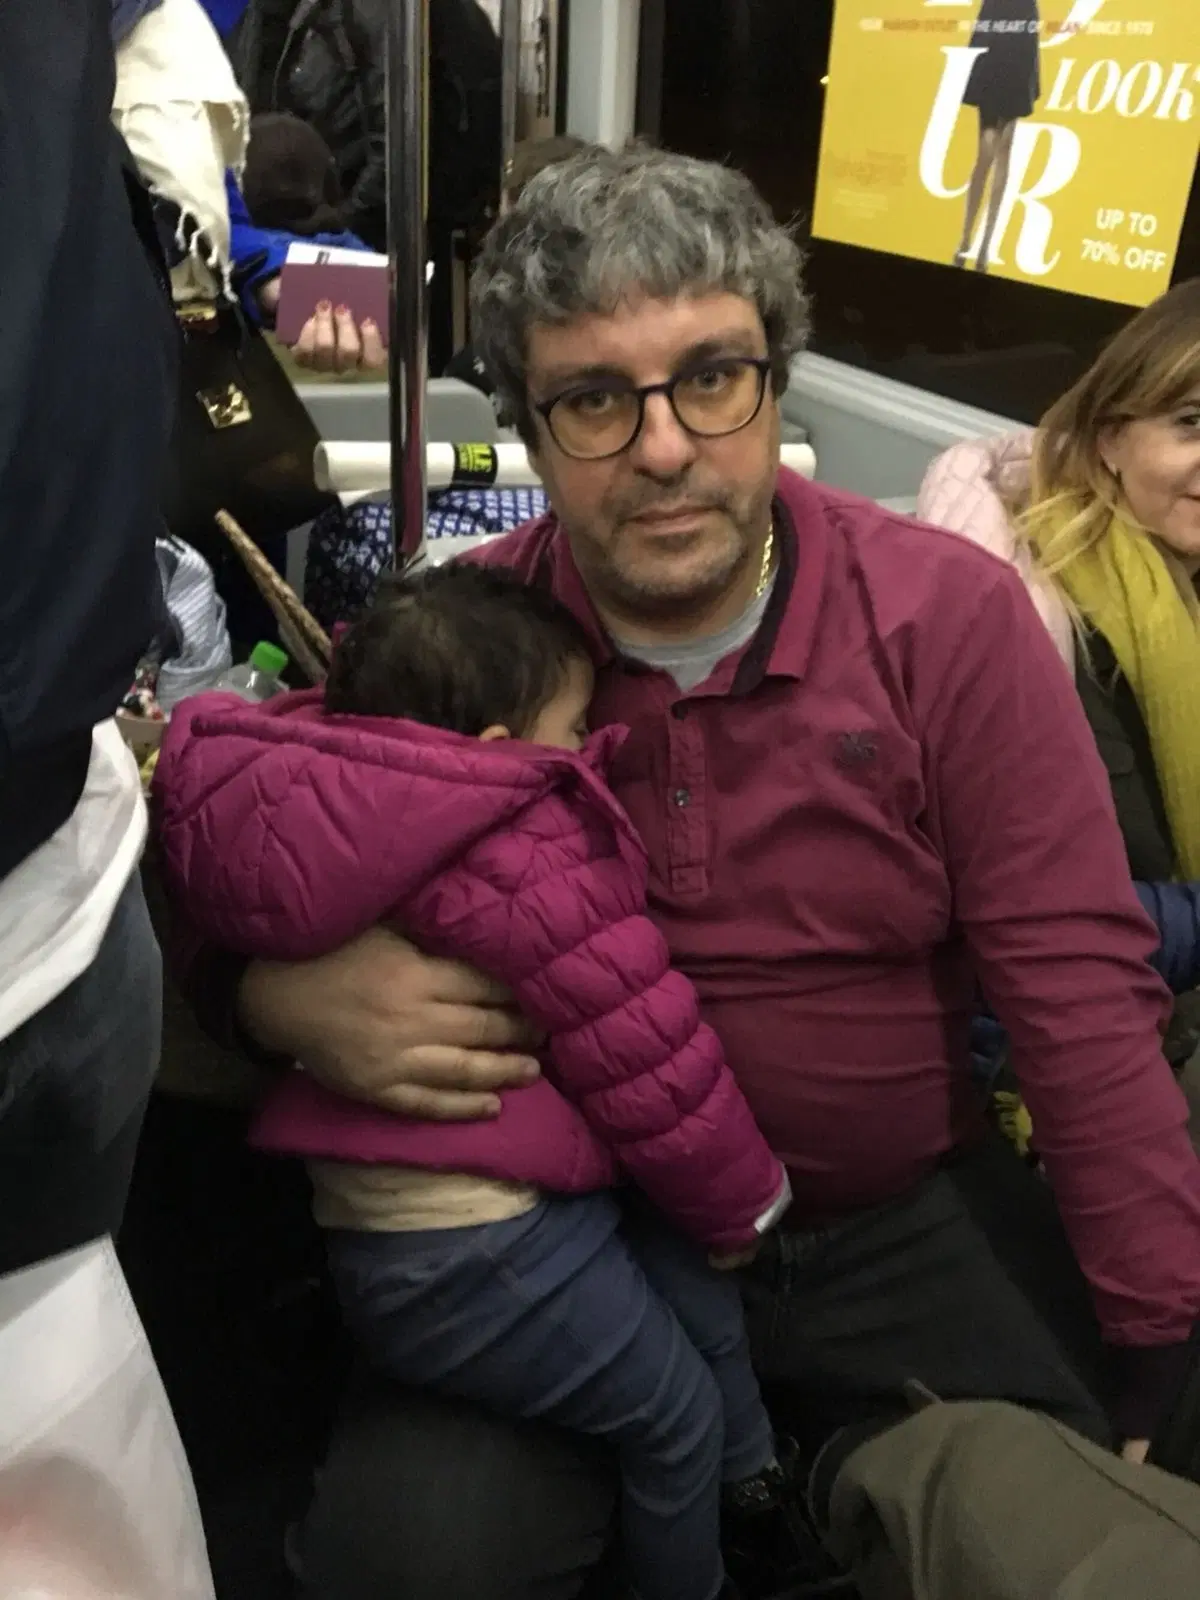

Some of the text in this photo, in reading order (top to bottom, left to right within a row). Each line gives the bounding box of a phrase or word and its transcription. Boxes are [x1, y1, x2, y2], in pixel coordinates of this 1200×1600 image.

[992, 19, 1027, 33] HEART
[1044, 57, 1200, 122] LOOK
[1096, 207, 1158, 237] UP TO
[1080, 238, 1167, 273] 70% OFF
